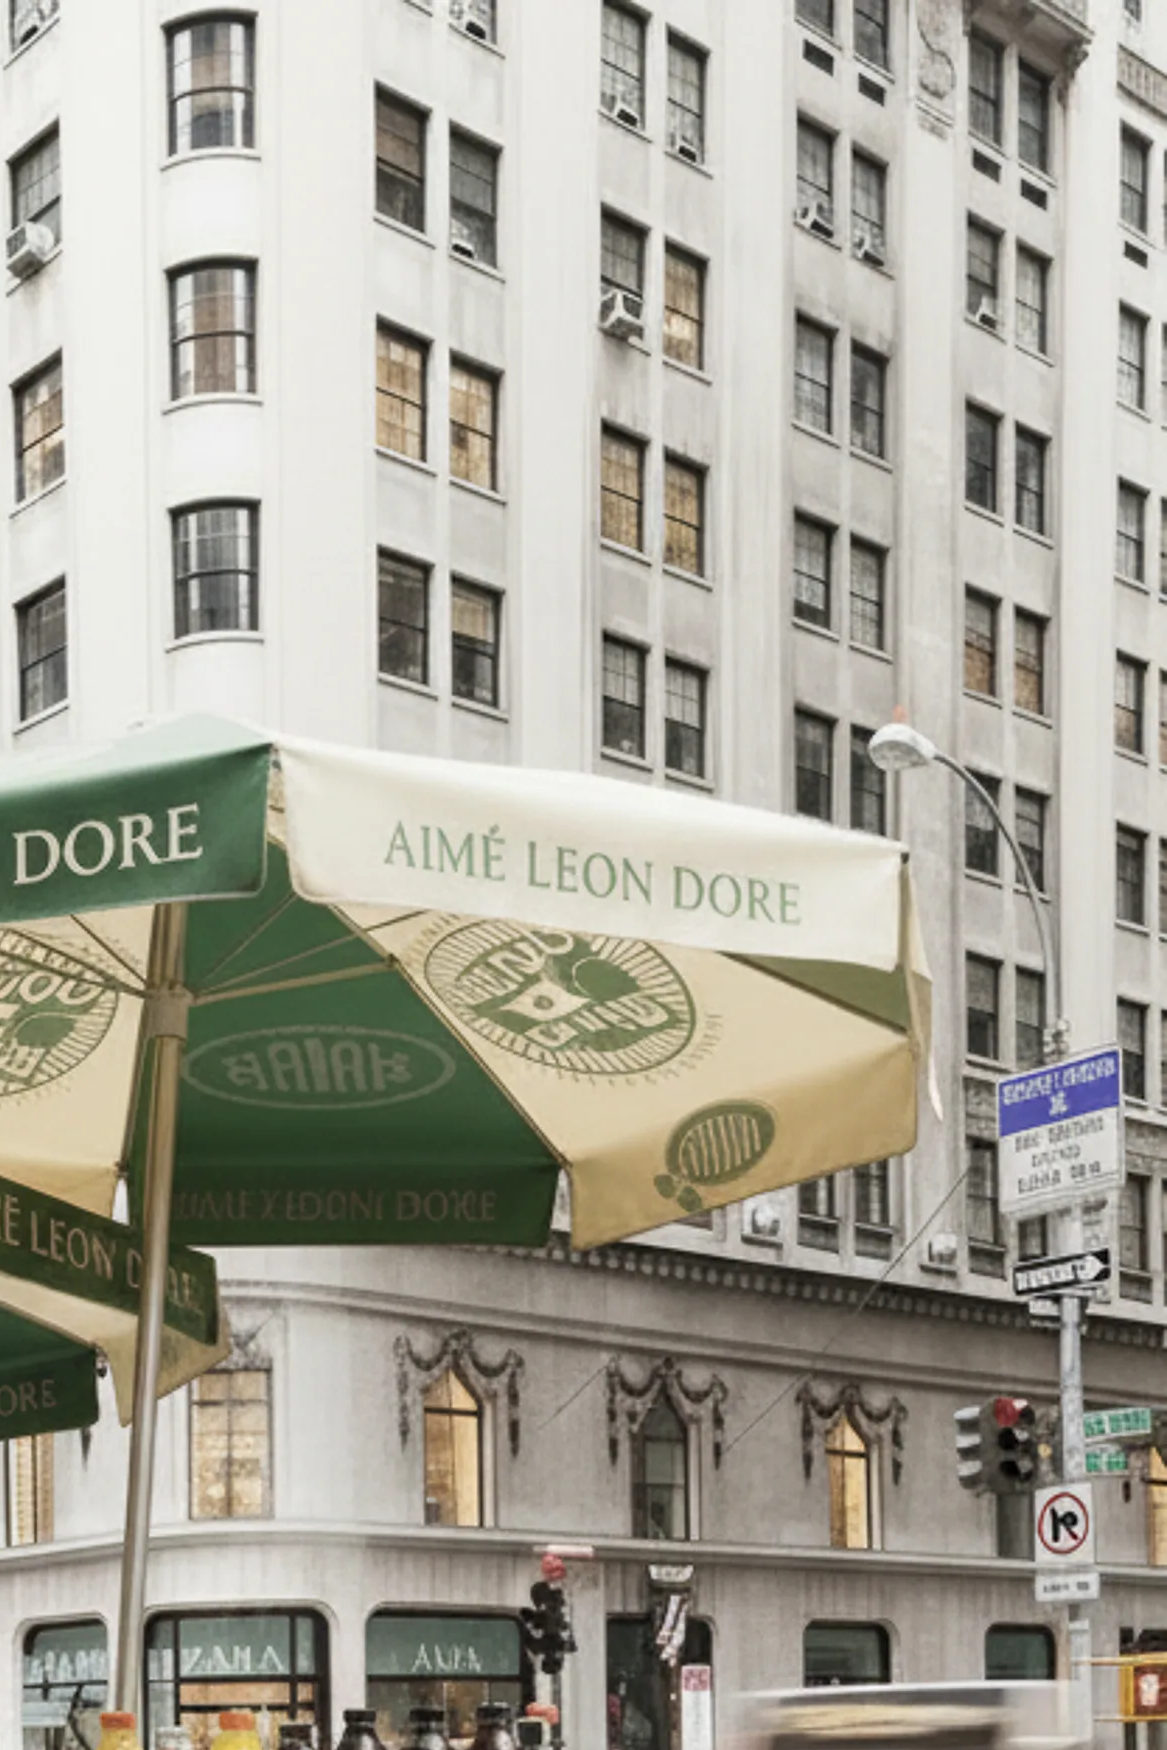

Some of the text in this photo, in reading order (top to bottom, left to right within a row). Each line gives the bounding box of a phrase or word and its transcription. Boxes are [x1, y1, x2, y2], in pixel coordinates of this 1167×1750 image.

[14, 802, 204, 887] DORE
[383, 819, 802, 926] AIMÉ LEON DORE
[31, 1210, 117, 1281] LEON
